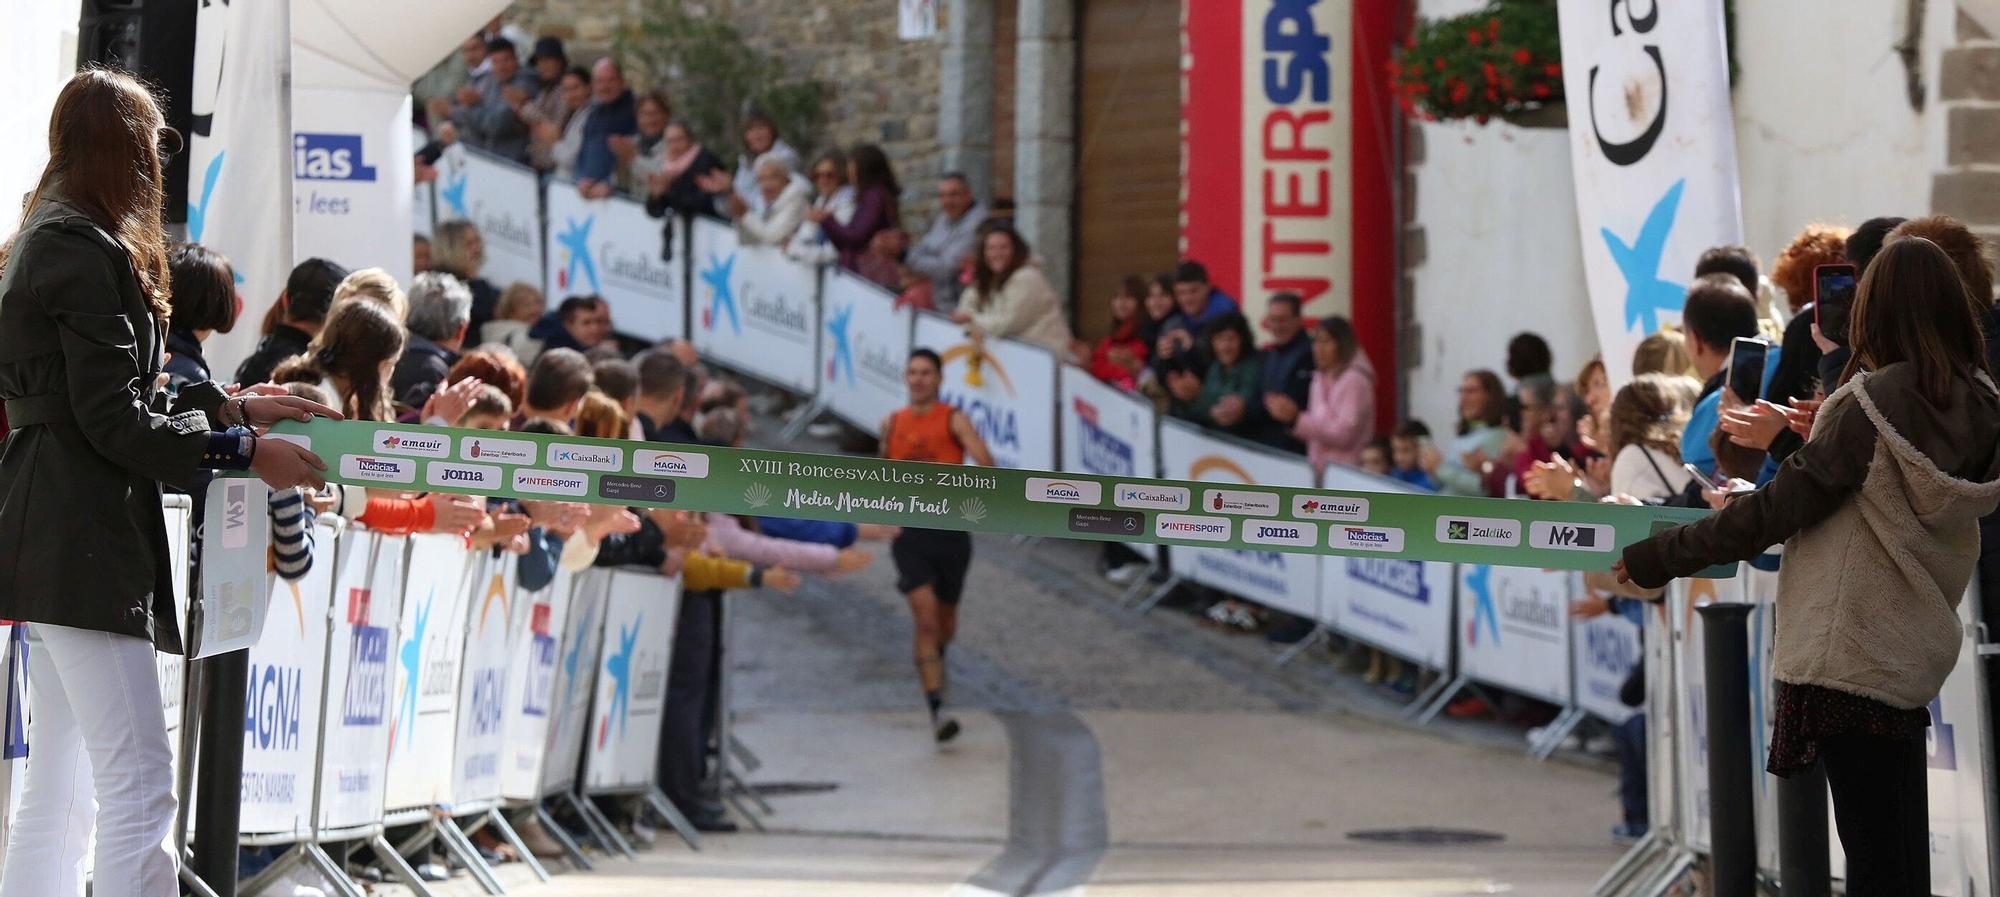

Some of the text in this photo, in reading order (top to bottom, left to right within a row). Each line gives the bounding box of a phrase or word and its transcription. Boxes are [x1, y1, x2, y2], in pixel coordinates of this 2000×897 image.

[296, 135, 352, 178] ias
[309, 190, 350, 215] lees
[402, 439, 442, 450] amavir
[571, 452, 610, 464] CaixaBank
[360, 461, 395, 472] Noticias
[654, 461, 687, 470] MAGNA
[739, 459, 997, 490] XVIII Roncesvalles Zubiri
[527, 477, 581, 488] INTERSPORT
[1047, 489, 1079, 497] MAGNA
[1138, 493, 1178, 503] CaixaBank
[784, 488, 950, 515] Media Maratón Trail
[1320, 503, 1360, 513] amavir
[1170, 523, 1224, 533] INTERSPORT
[1350, 532, 1383, 541] Noticias
[245, 664, 300, 750] AGNA
